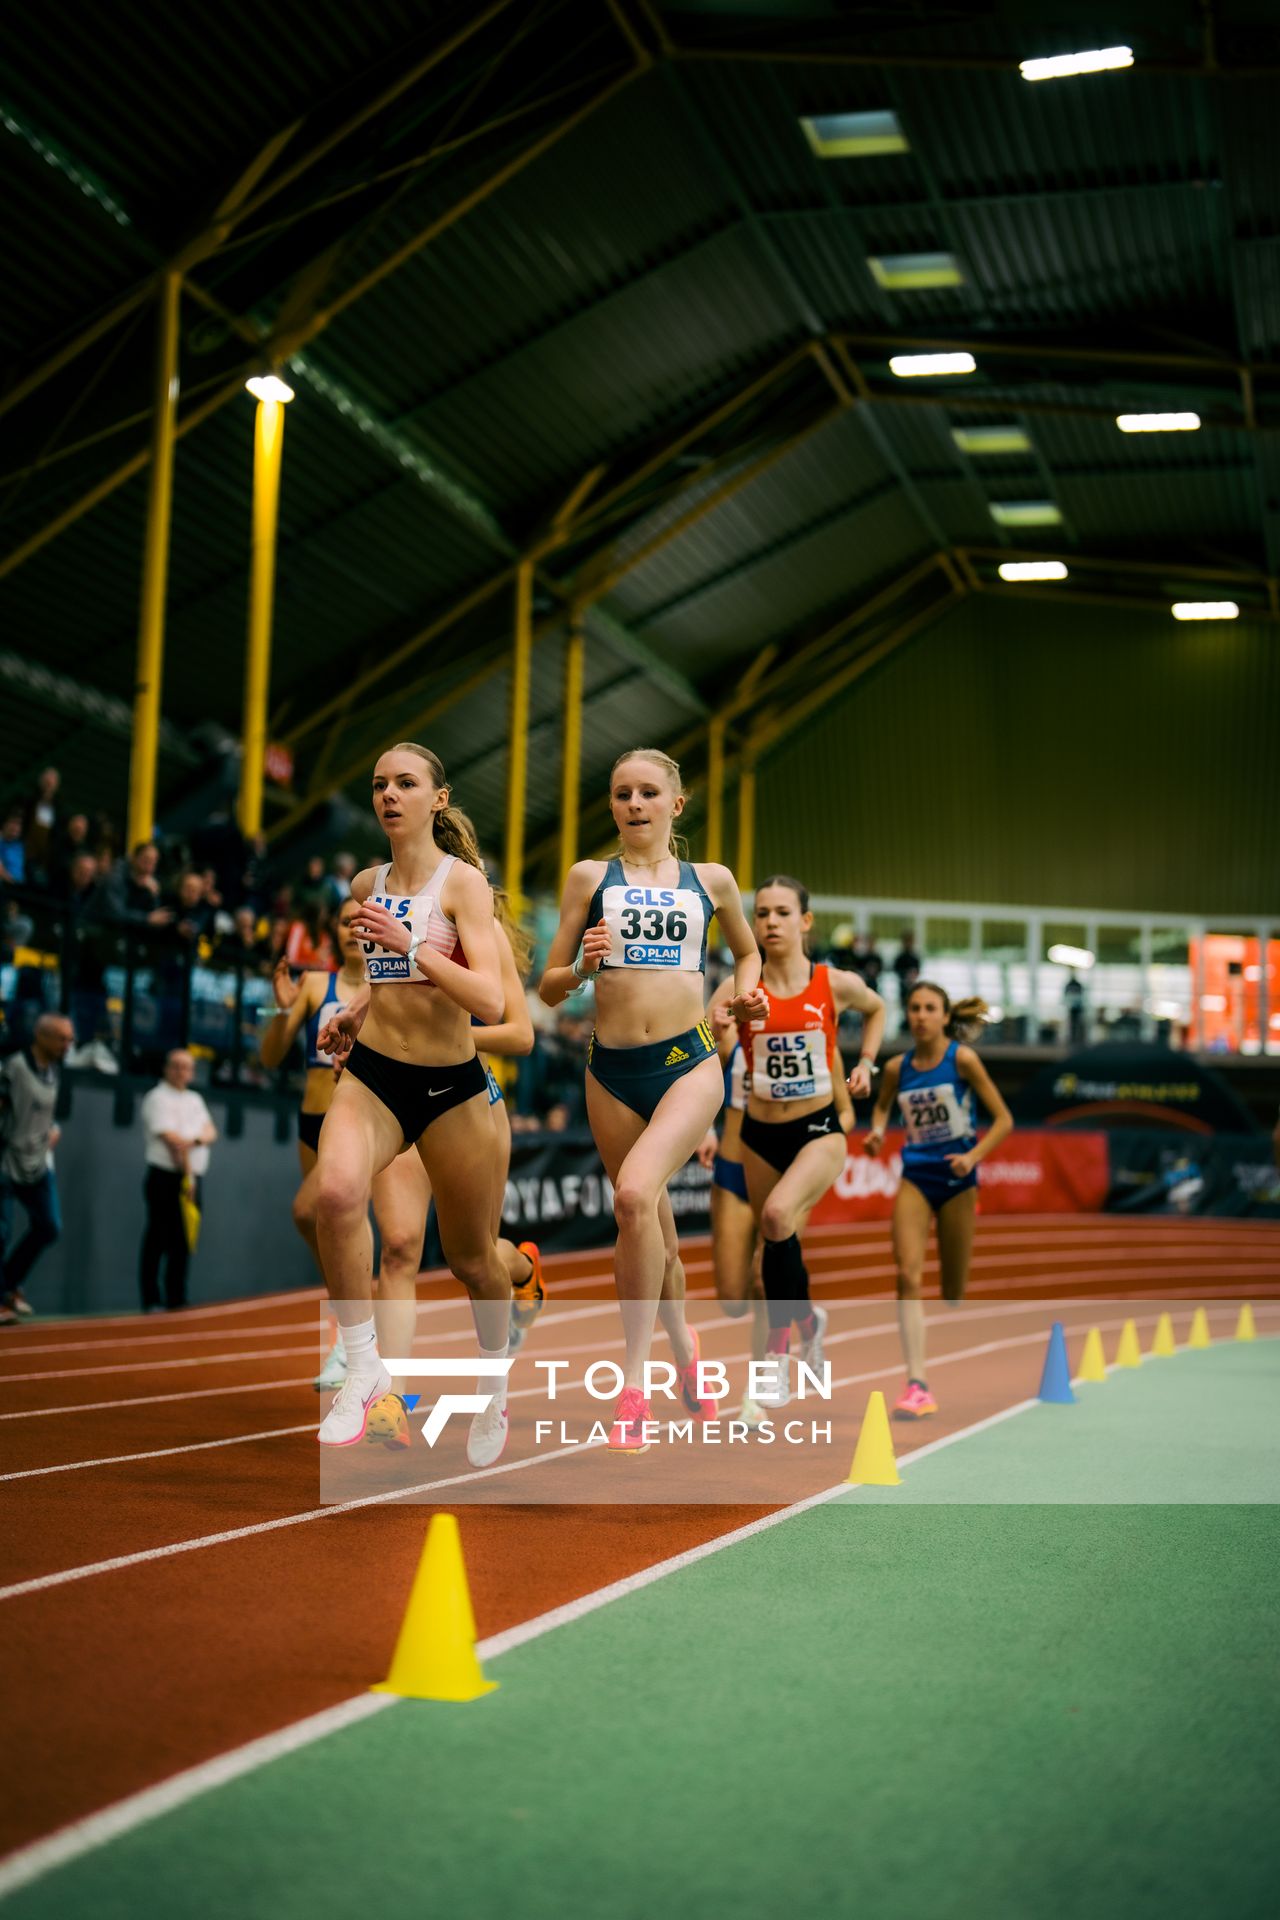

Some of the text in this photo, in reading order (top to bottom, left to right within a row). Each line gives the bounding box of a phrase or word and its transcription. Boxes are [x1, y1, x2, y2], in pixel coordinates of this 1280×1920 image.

[620, 908, 688, 942] 336
[647, 948, 679, 958] PLAN
[382, 961, 408, 971] PLAN
[664, 1052, 690, 1066] adidas
[766, 1052, 814, 1079] 651
[911, 1103, 950, 1128] 230
